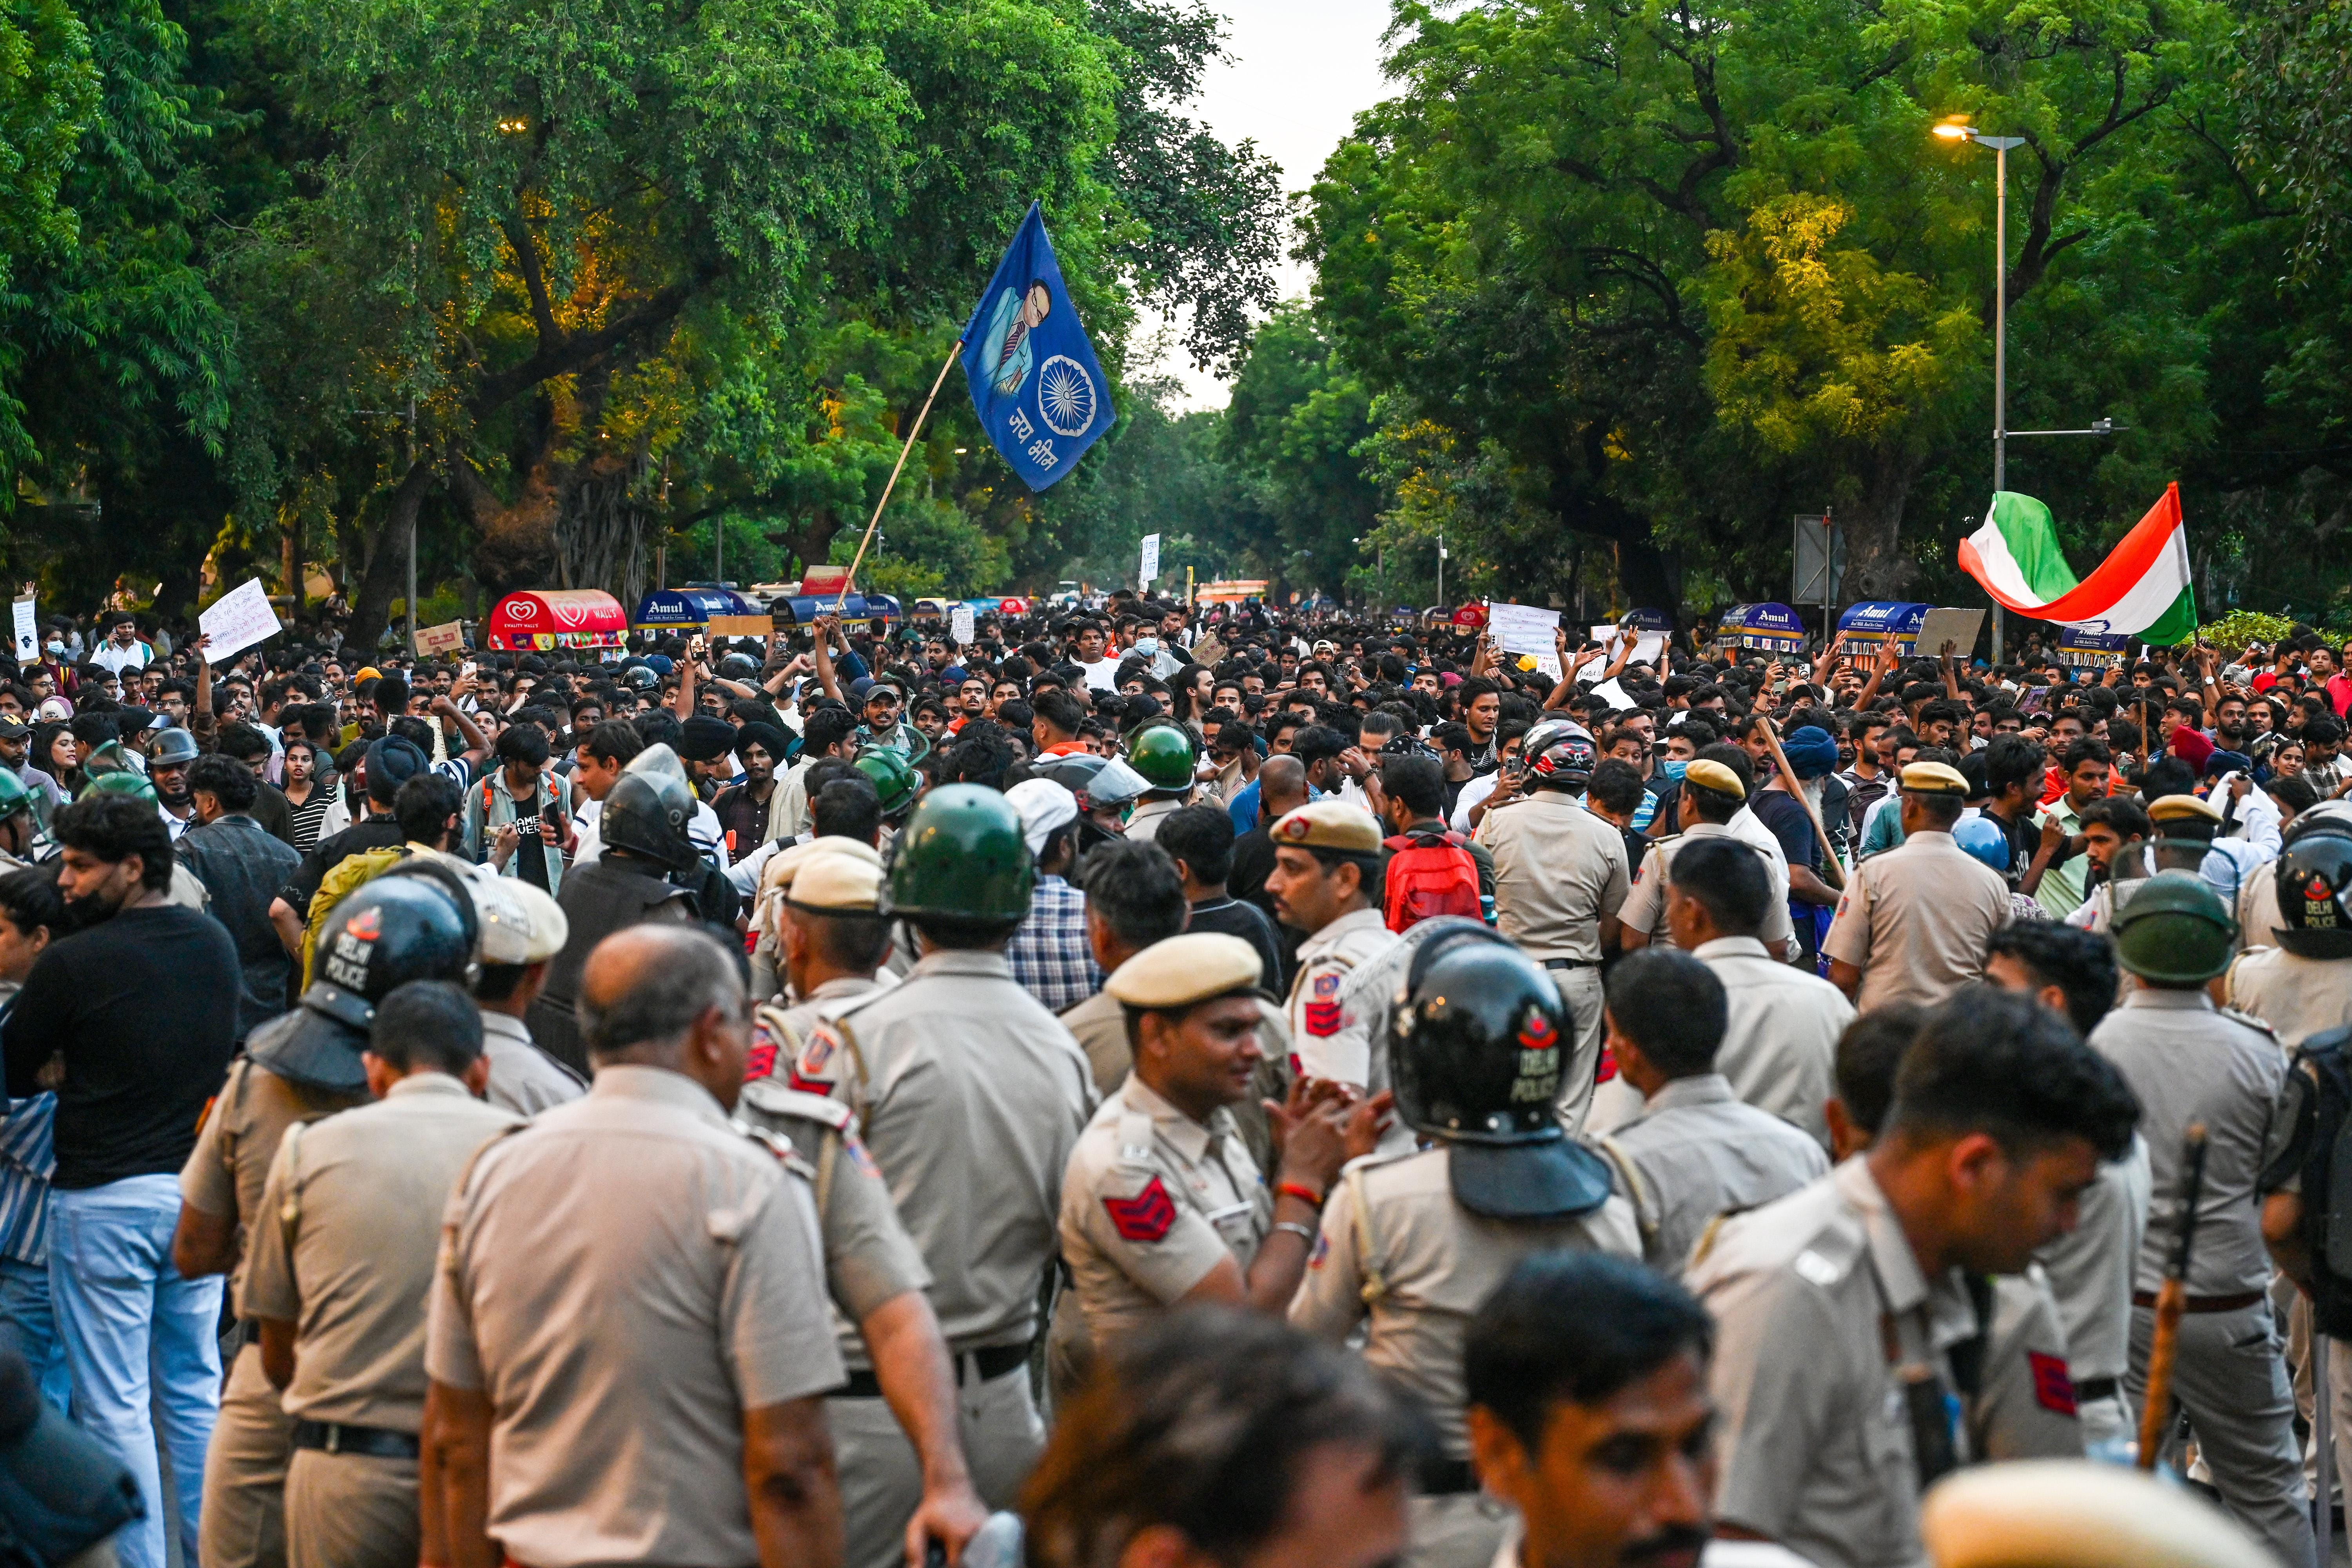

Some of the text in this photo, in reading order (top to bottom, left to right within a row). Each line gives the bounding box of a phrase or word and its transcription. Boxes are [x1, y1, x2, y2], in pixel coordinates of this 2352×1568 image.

[1009, 407, 1034, 444] जय
[1028, 439, 1059, 471] भीम
[593, 608, 617, 619] WALL'S
[648, 601, 683, 615] Amul
[1856, 604, 1895, 618] Amul
[1638, 614, 1661, 623] Amul
[1759, 610, 1788, 622] Amul
[516, 815, 540, 827] AME
[517, 824, 541, 834] VER
[2305, 900, 2333, 915] DELHI
[2305, 916, 2337, 929] POLICE
[335, 931, 374, 965] DELHI
[325, 953, 370, 991] POLICE
